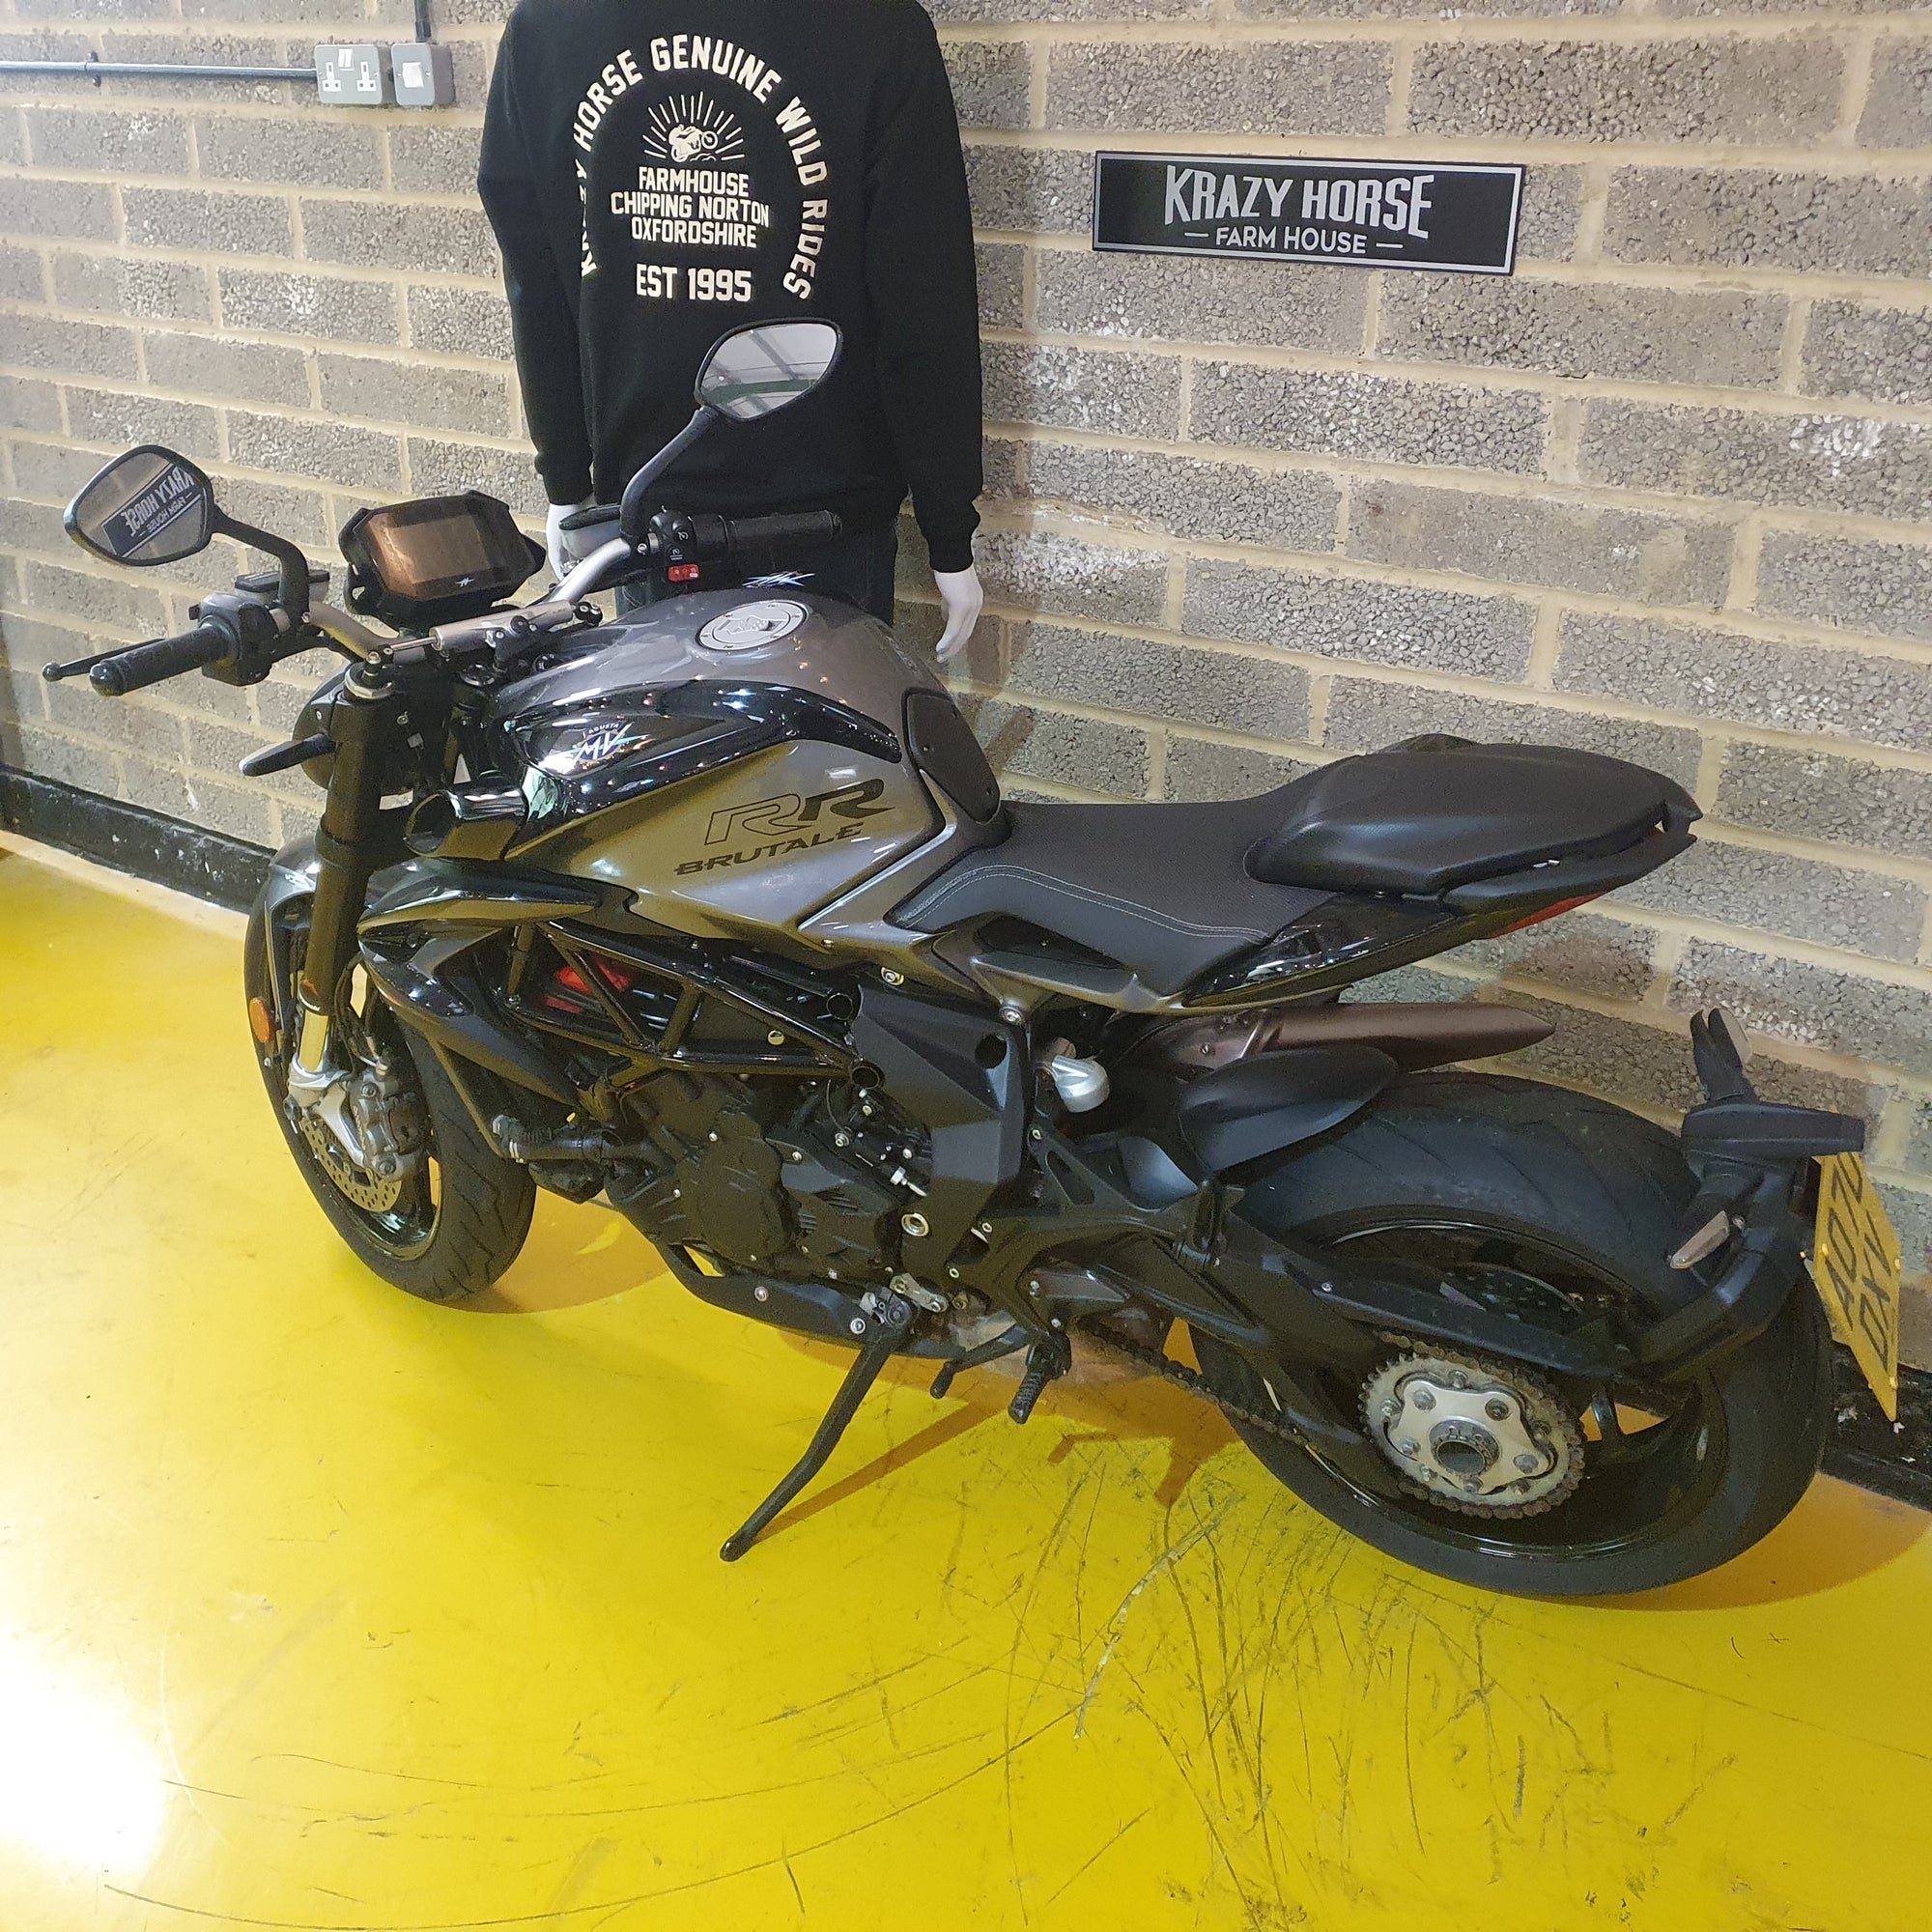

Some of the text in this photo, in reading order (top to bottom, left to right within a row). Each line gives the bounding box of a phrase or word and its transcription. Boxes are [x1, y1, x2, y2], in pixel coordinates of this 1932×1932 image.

[650, 34, 782, 104] GENUINE
[573, 48, 644, 153] HORSE
[639, 165, 750, 198] FARMHOUSE
[775, 96, 828, 300] WILD RIDES
[1164, 164, 1435, 240] KRAZY HORSE
[611, 191, 770, 229] CHIPPING NORTON
[631, 215, 757, 249] OXFORDSHIRE
[1215, 225, 1368, 255] FARM HOUSE
[637, 263, 752, 302] EST 1995
[704, 779, 895, 846] RR
[674, 821, 864, 876] BRUTALE
